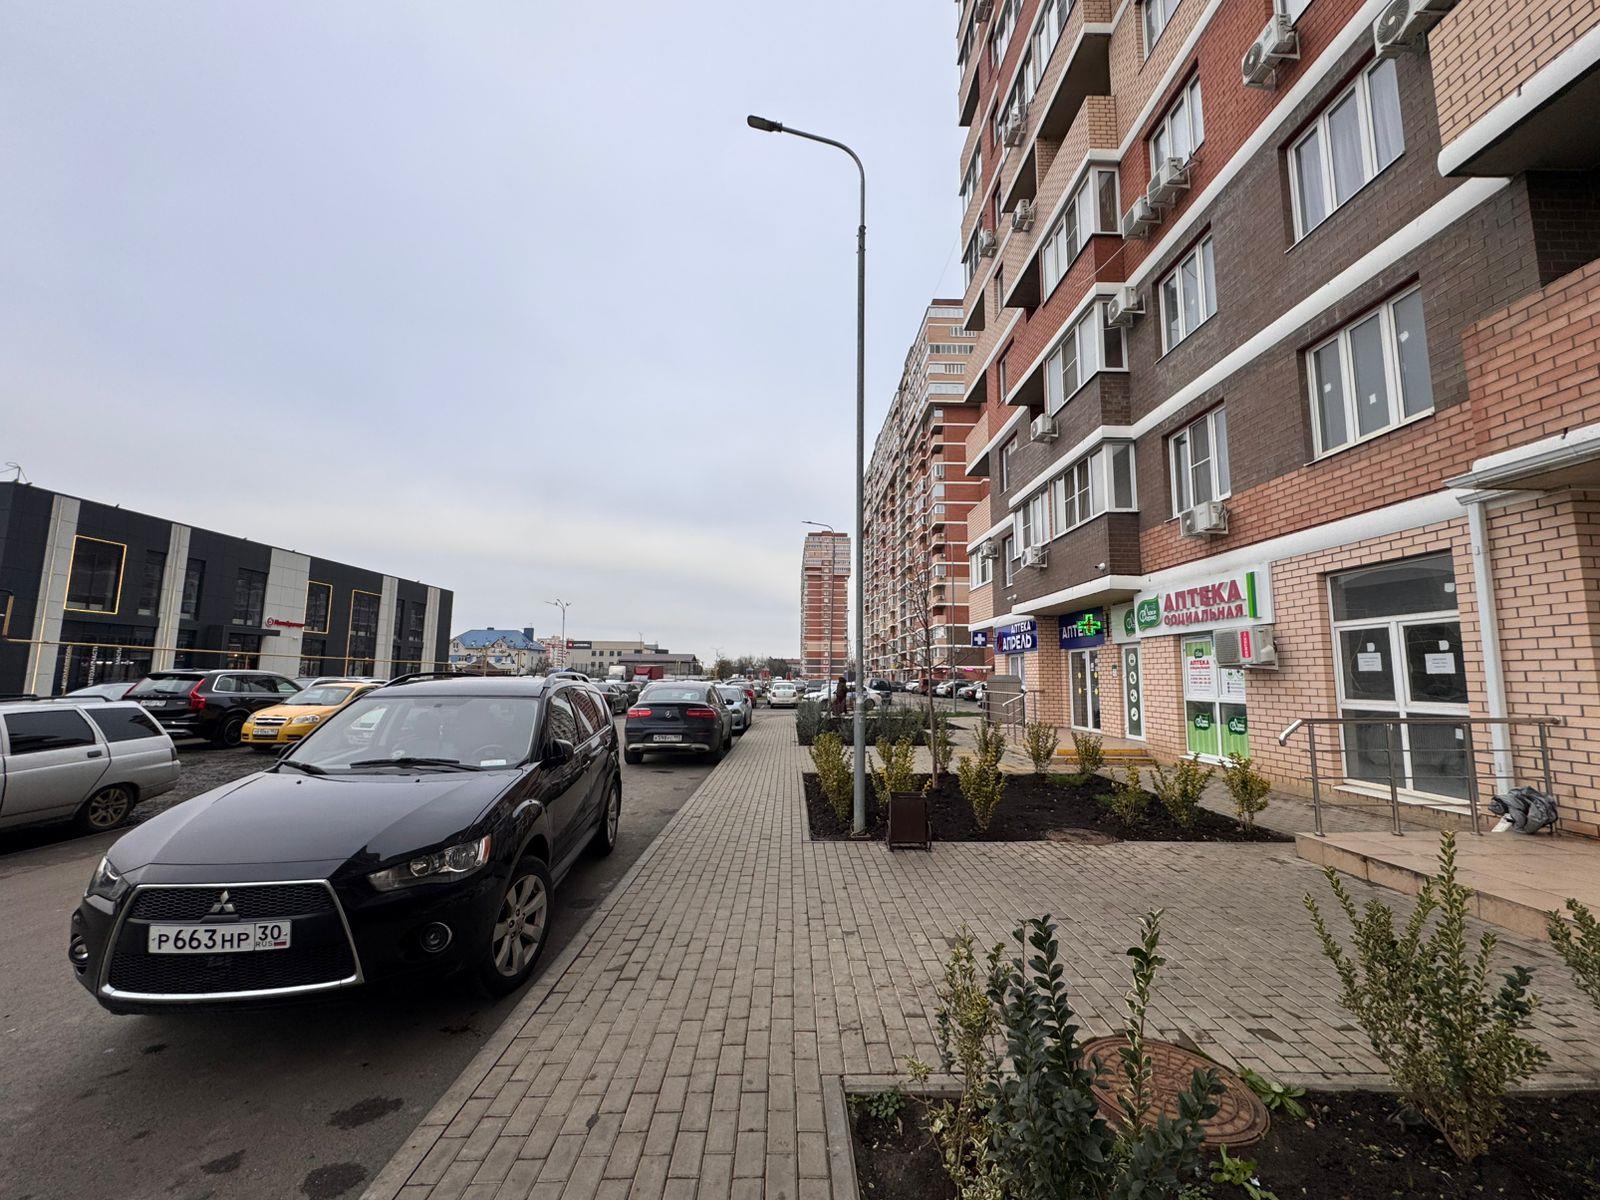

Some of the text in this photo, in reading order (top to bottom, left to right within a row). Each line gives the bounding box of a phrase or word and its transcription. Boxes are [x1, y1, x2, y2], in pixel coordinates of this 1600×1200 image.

[1163, 579, 1242, 612] АПТЕКА
[1163, 604, 1244, 627] СОЦИАЛЬНАЯ
[1010, 620, 1031, 634] АПТЕКА
[1062, 623, 1093, 639] АПТЕ
[1002, 633, 1032, 651] АПРЕЛЬ
[258, 924, 281, 942] 30
